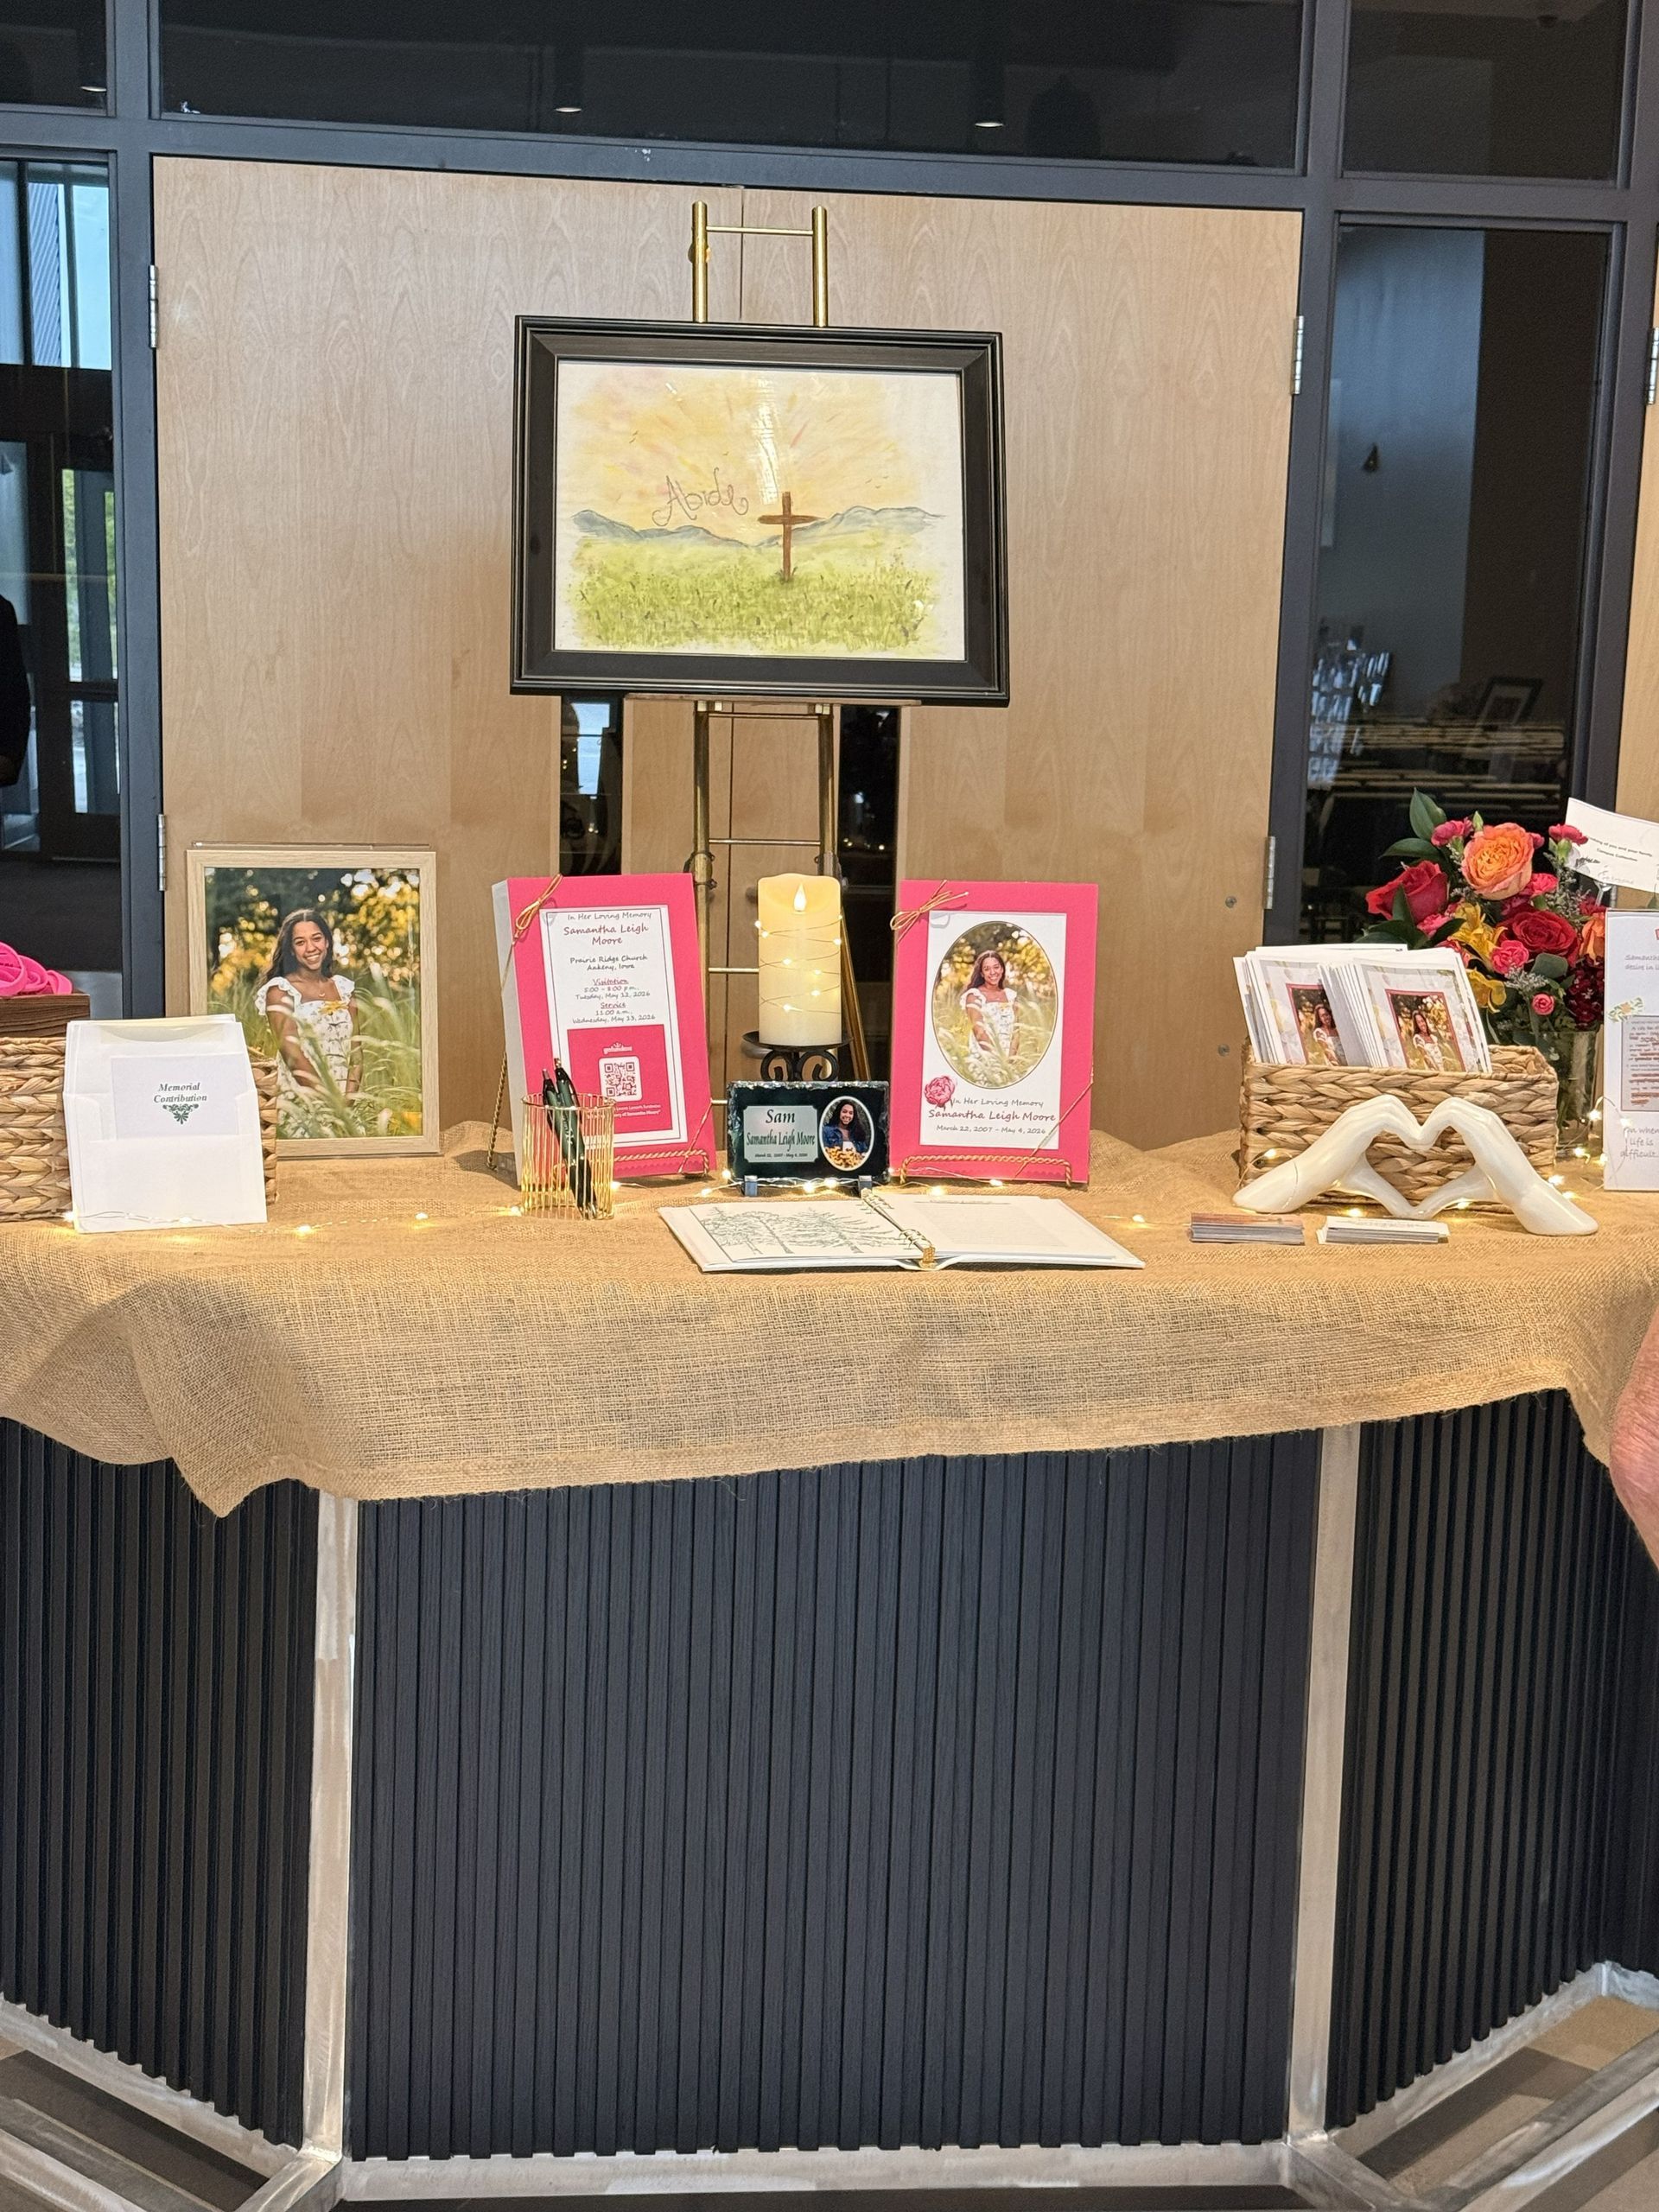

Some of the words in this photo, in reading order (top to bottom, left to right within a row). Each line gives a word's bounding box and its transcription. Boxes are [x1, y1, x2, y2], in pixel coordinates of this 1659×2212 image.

[652, 467, 749, 526] Abide
[563, 925, 616, 936] Samantha
[620, 922, 648, 934] Leigh
[592, 936, 622, 945] Moore
[158, 1083, 200, 1091] Memorial
[154, 1094, 207, 1103] Contribution
[982, 1098, 1008, 1107] Loving
[1011, 1099, 1044, 1108] Memory
[766, 1109, 796, 1124] Sam
[928, 1109, 985, 1120] Samantha
[988, 1110, 1020, 1122] Leigh
[1022, 1112, 1056, 1122] Moore
[746, 1129, 777, 1146] Samantha
[779, 1129, 796, 1152] Leigh
[796, 1133, 816, 1146] Moore
